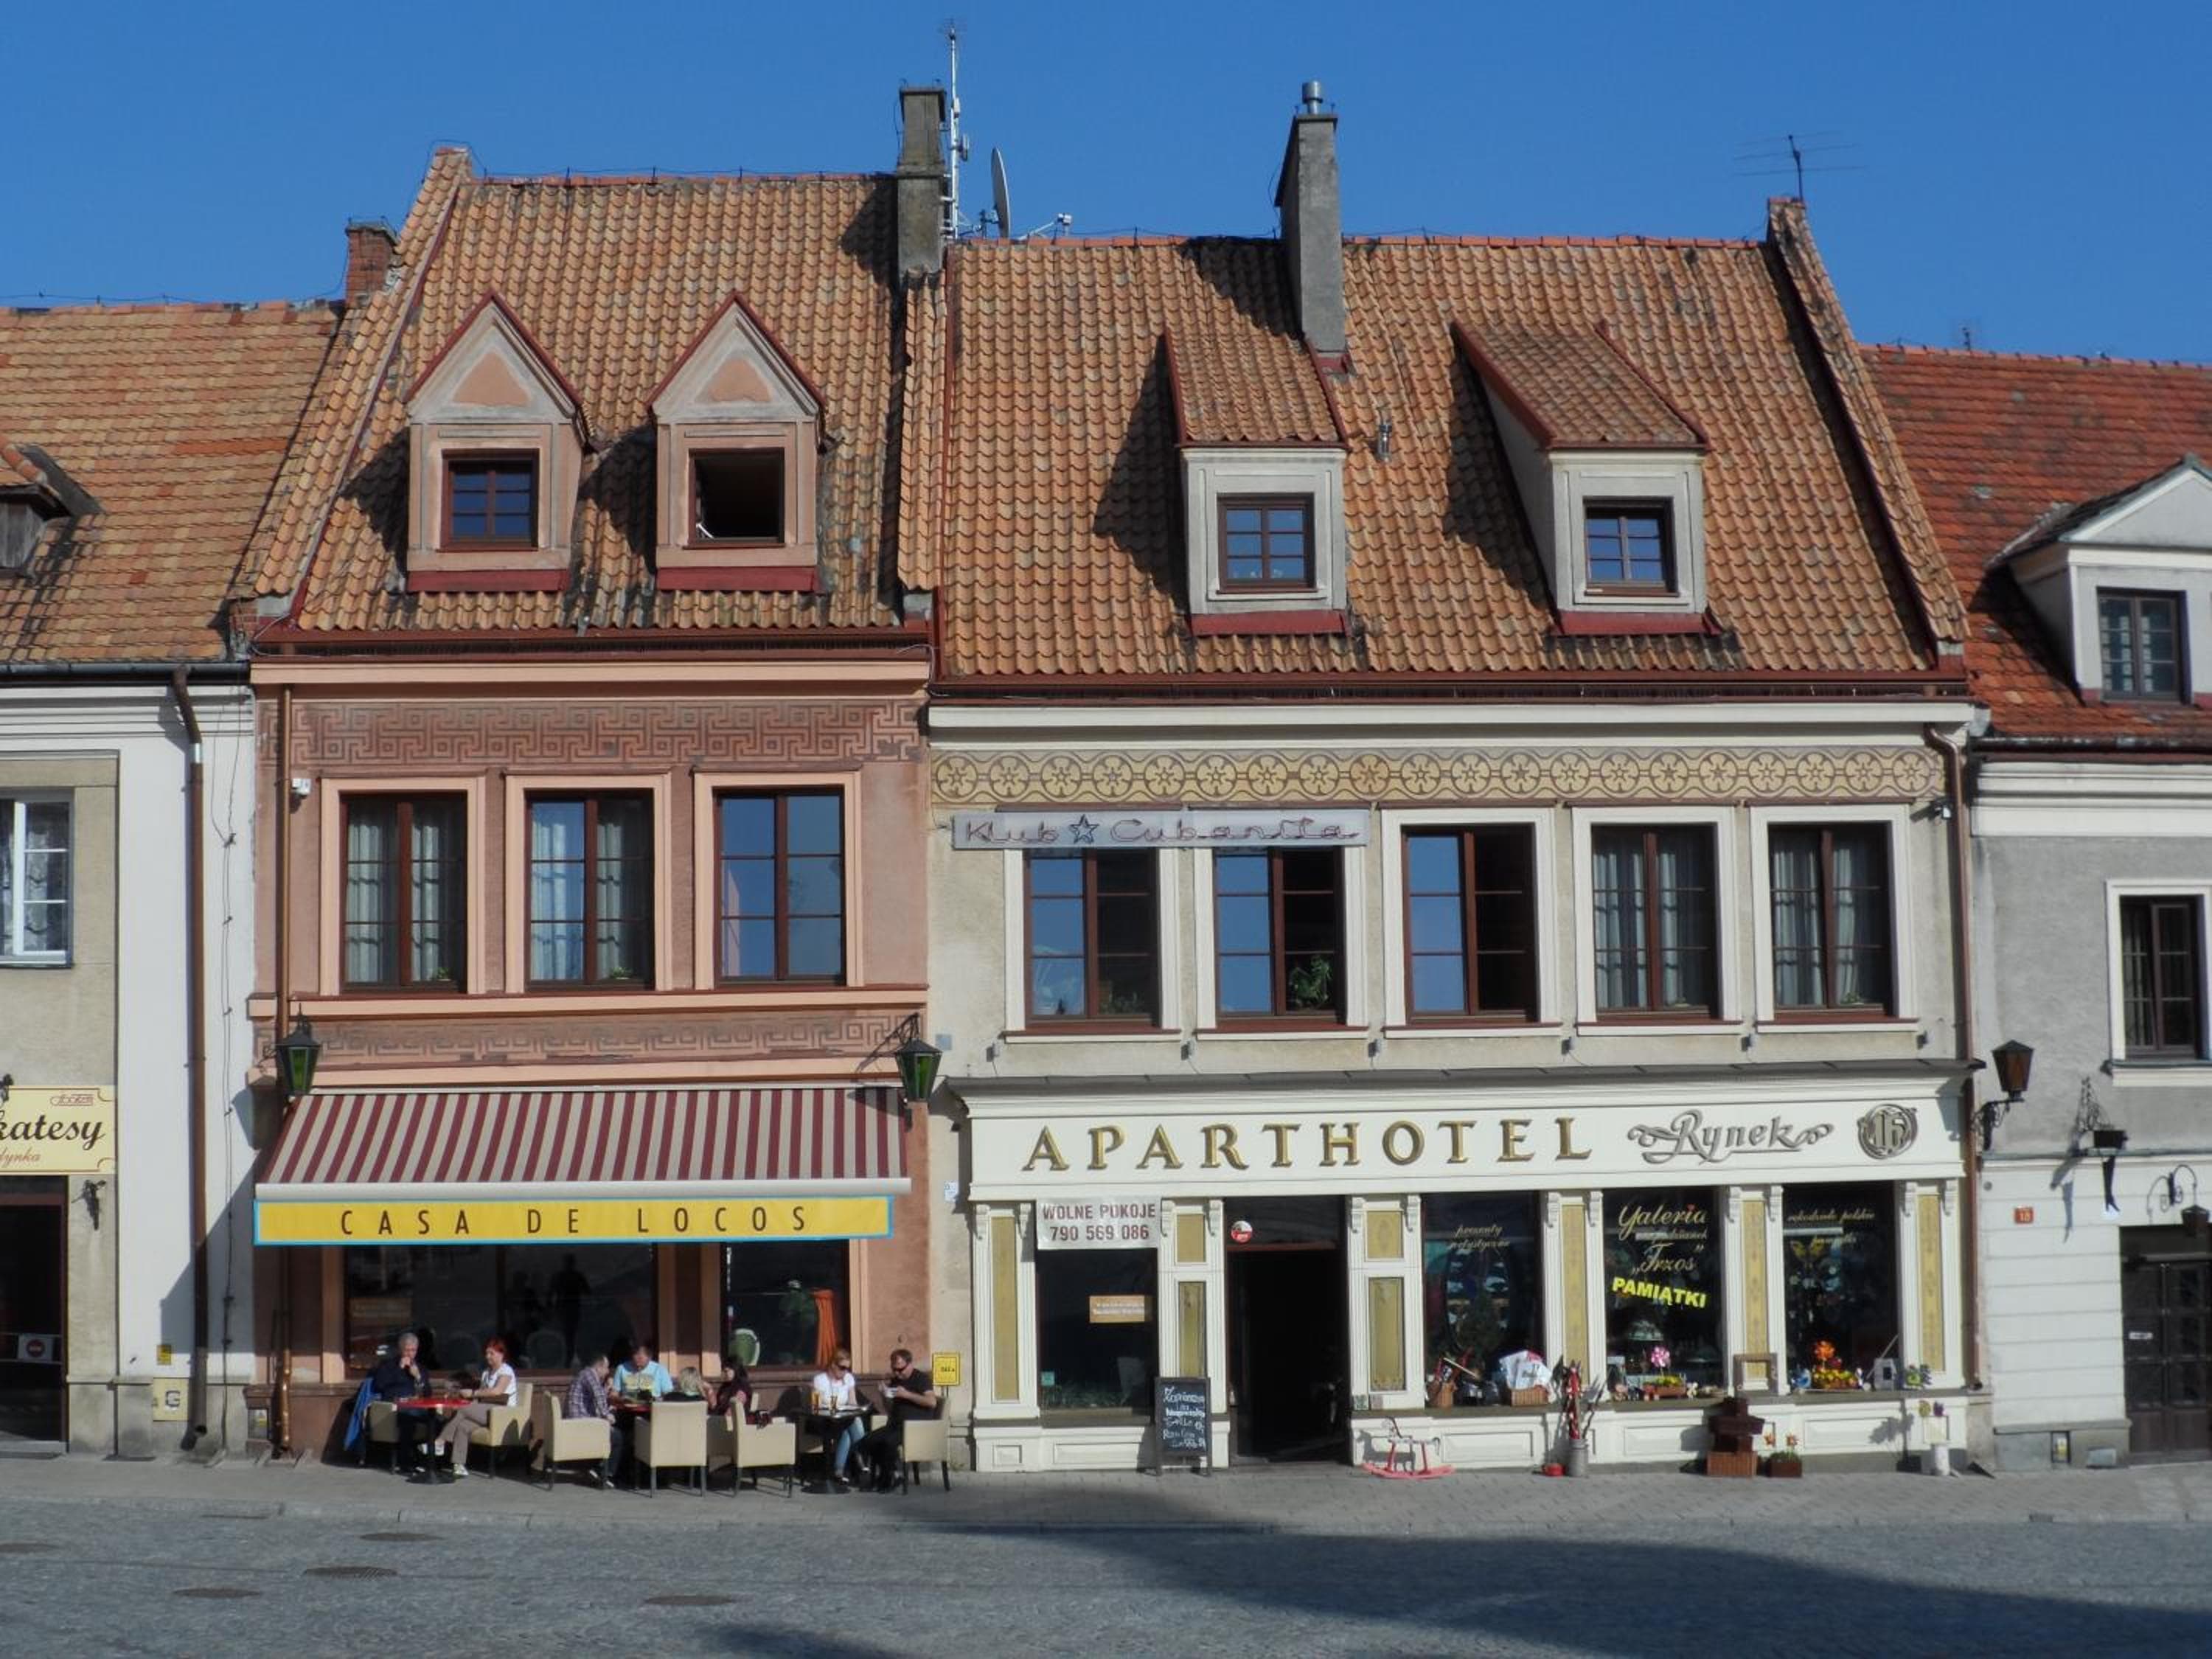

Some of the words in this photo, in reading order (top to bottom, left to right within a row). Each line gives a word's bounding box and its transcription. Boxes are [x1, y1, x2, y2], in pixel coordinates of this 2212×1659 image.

[966, 820, 1060, 844] Klub
[1022, 1116, 1593, 1172] APARTHOTEL
[1627, 1108, 1834, 1165] Rynek
[341, 1208, 470, 1237] CASA
[528, 1208, 579, 1235] DE
[638, 1206, 805, 1234] LOCOS
[1043, 1204, 1093, 1220] WOLNE
[1099, 1203, 1156, 1219] POKOJE
[1050, 1225, 1079, 1242] 790
[1086, 1225, 1115, 1241] 569
[1122, 1223, 1150, 1240] 086
[1612, 1276, 1708, 1309] PAMIĄTKI
